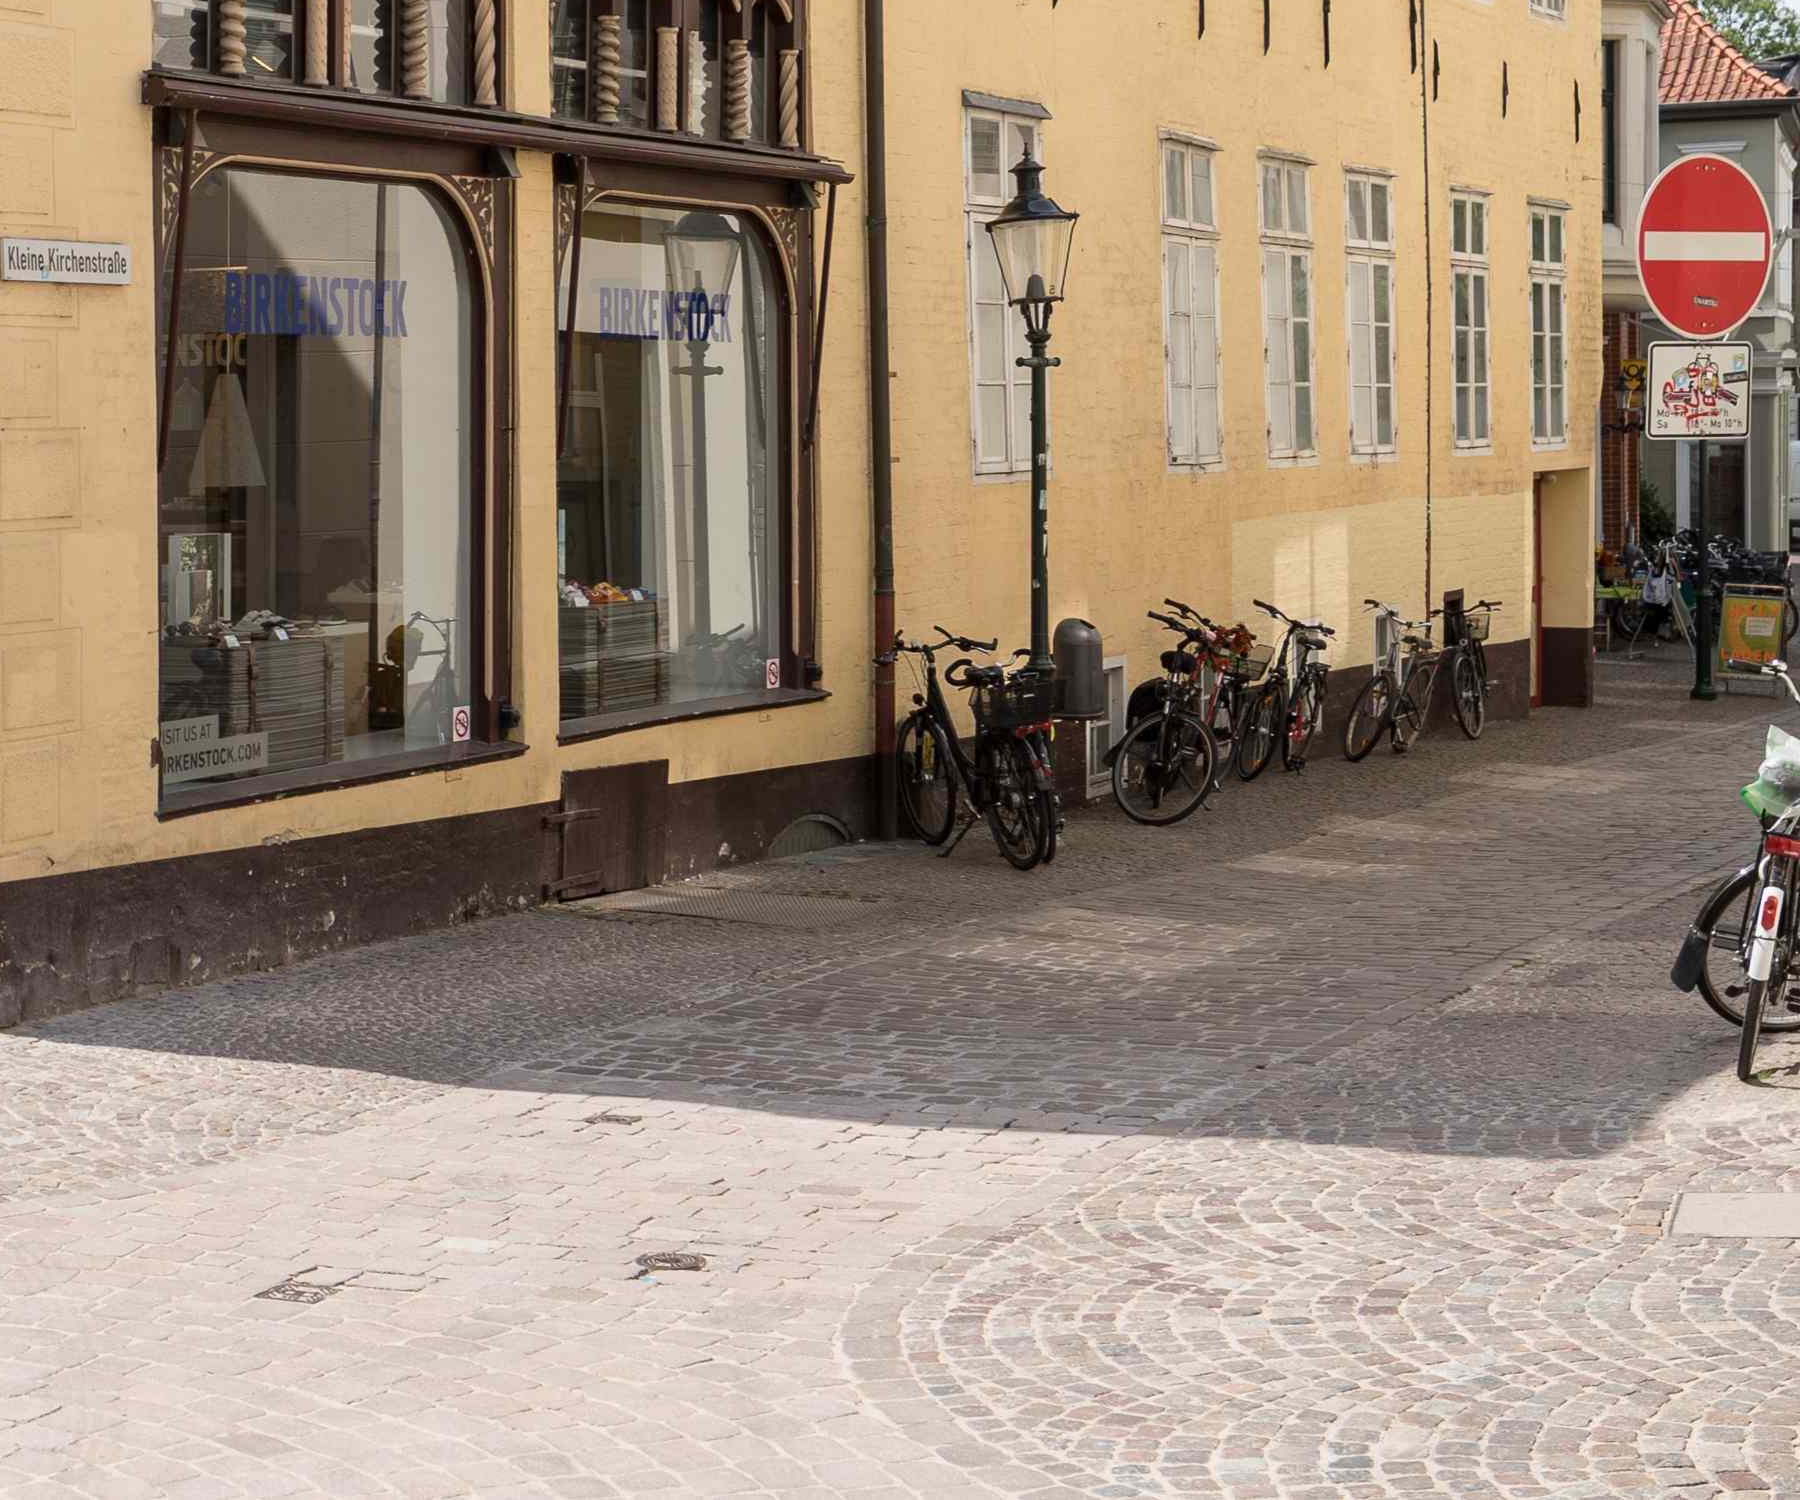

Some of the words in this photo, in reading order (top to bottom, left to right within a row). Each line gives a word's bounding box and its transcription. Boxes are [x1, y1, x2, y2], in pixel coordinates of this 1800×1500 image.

[7, 246, 44, 271] Kleine
[48, 248, 127, 275] Kirchenstraße
[225, 272, 408, 338] BIRKENSTOCK
[600, 288, 732, 342] BIRKENSTOCK
[184, 726, 198, 742] US
[200, 723, 212, 738] AT
